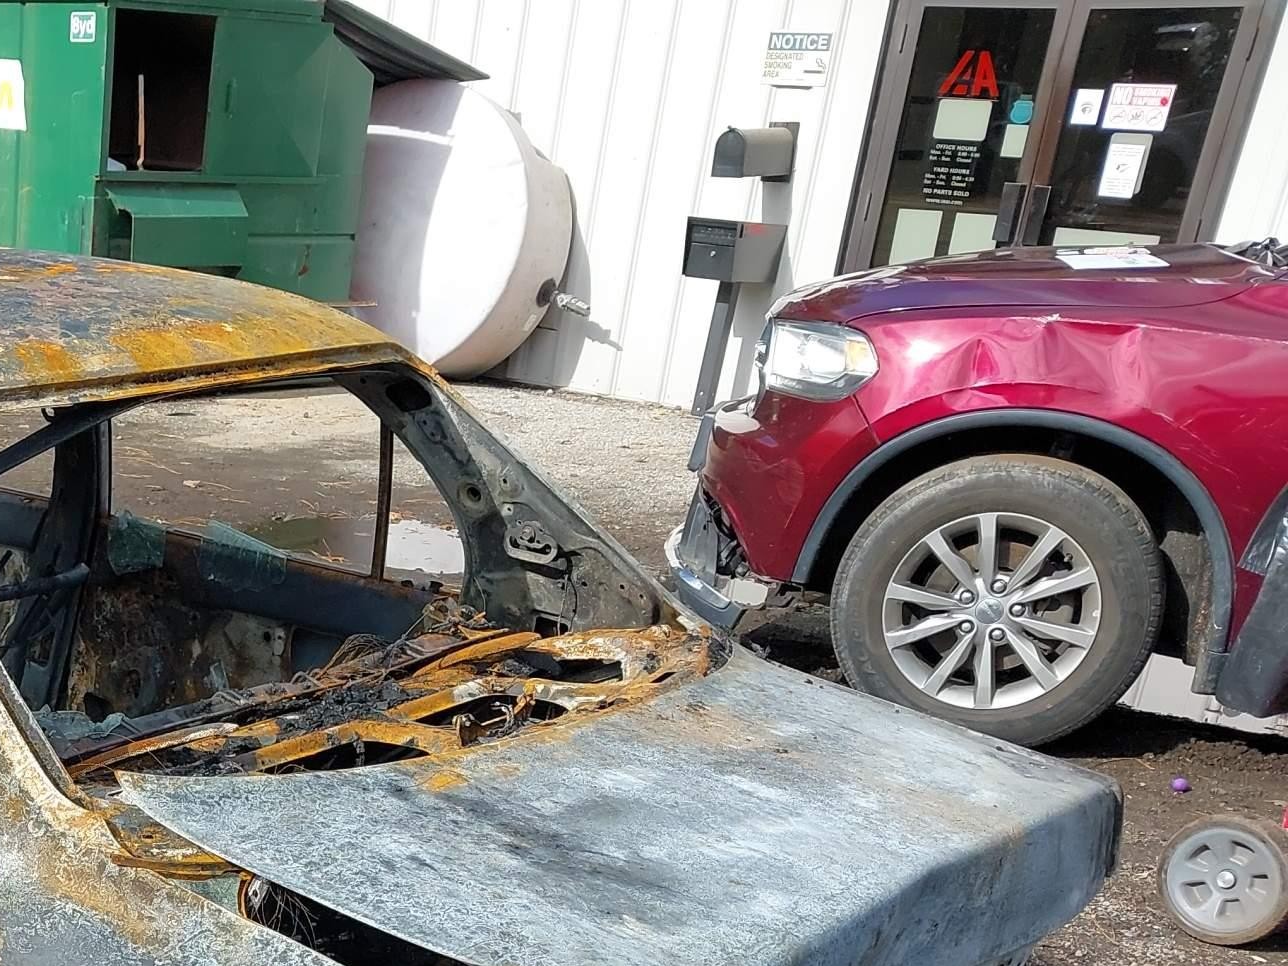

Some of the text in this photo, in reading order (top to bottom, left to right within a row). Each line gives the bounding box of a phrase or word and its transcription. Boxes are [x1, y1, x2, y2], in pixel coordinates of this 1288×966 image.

[770, 34, 829, 49] NOTICE
[766, 52, 807, 60] DESIGNATED
[764, 61, 792, 69] SMOKING
[762, 70, 779, 78] AREA
[1113, 87, 1133, 105] NO
[933, 188, 952, 196] PARTS
